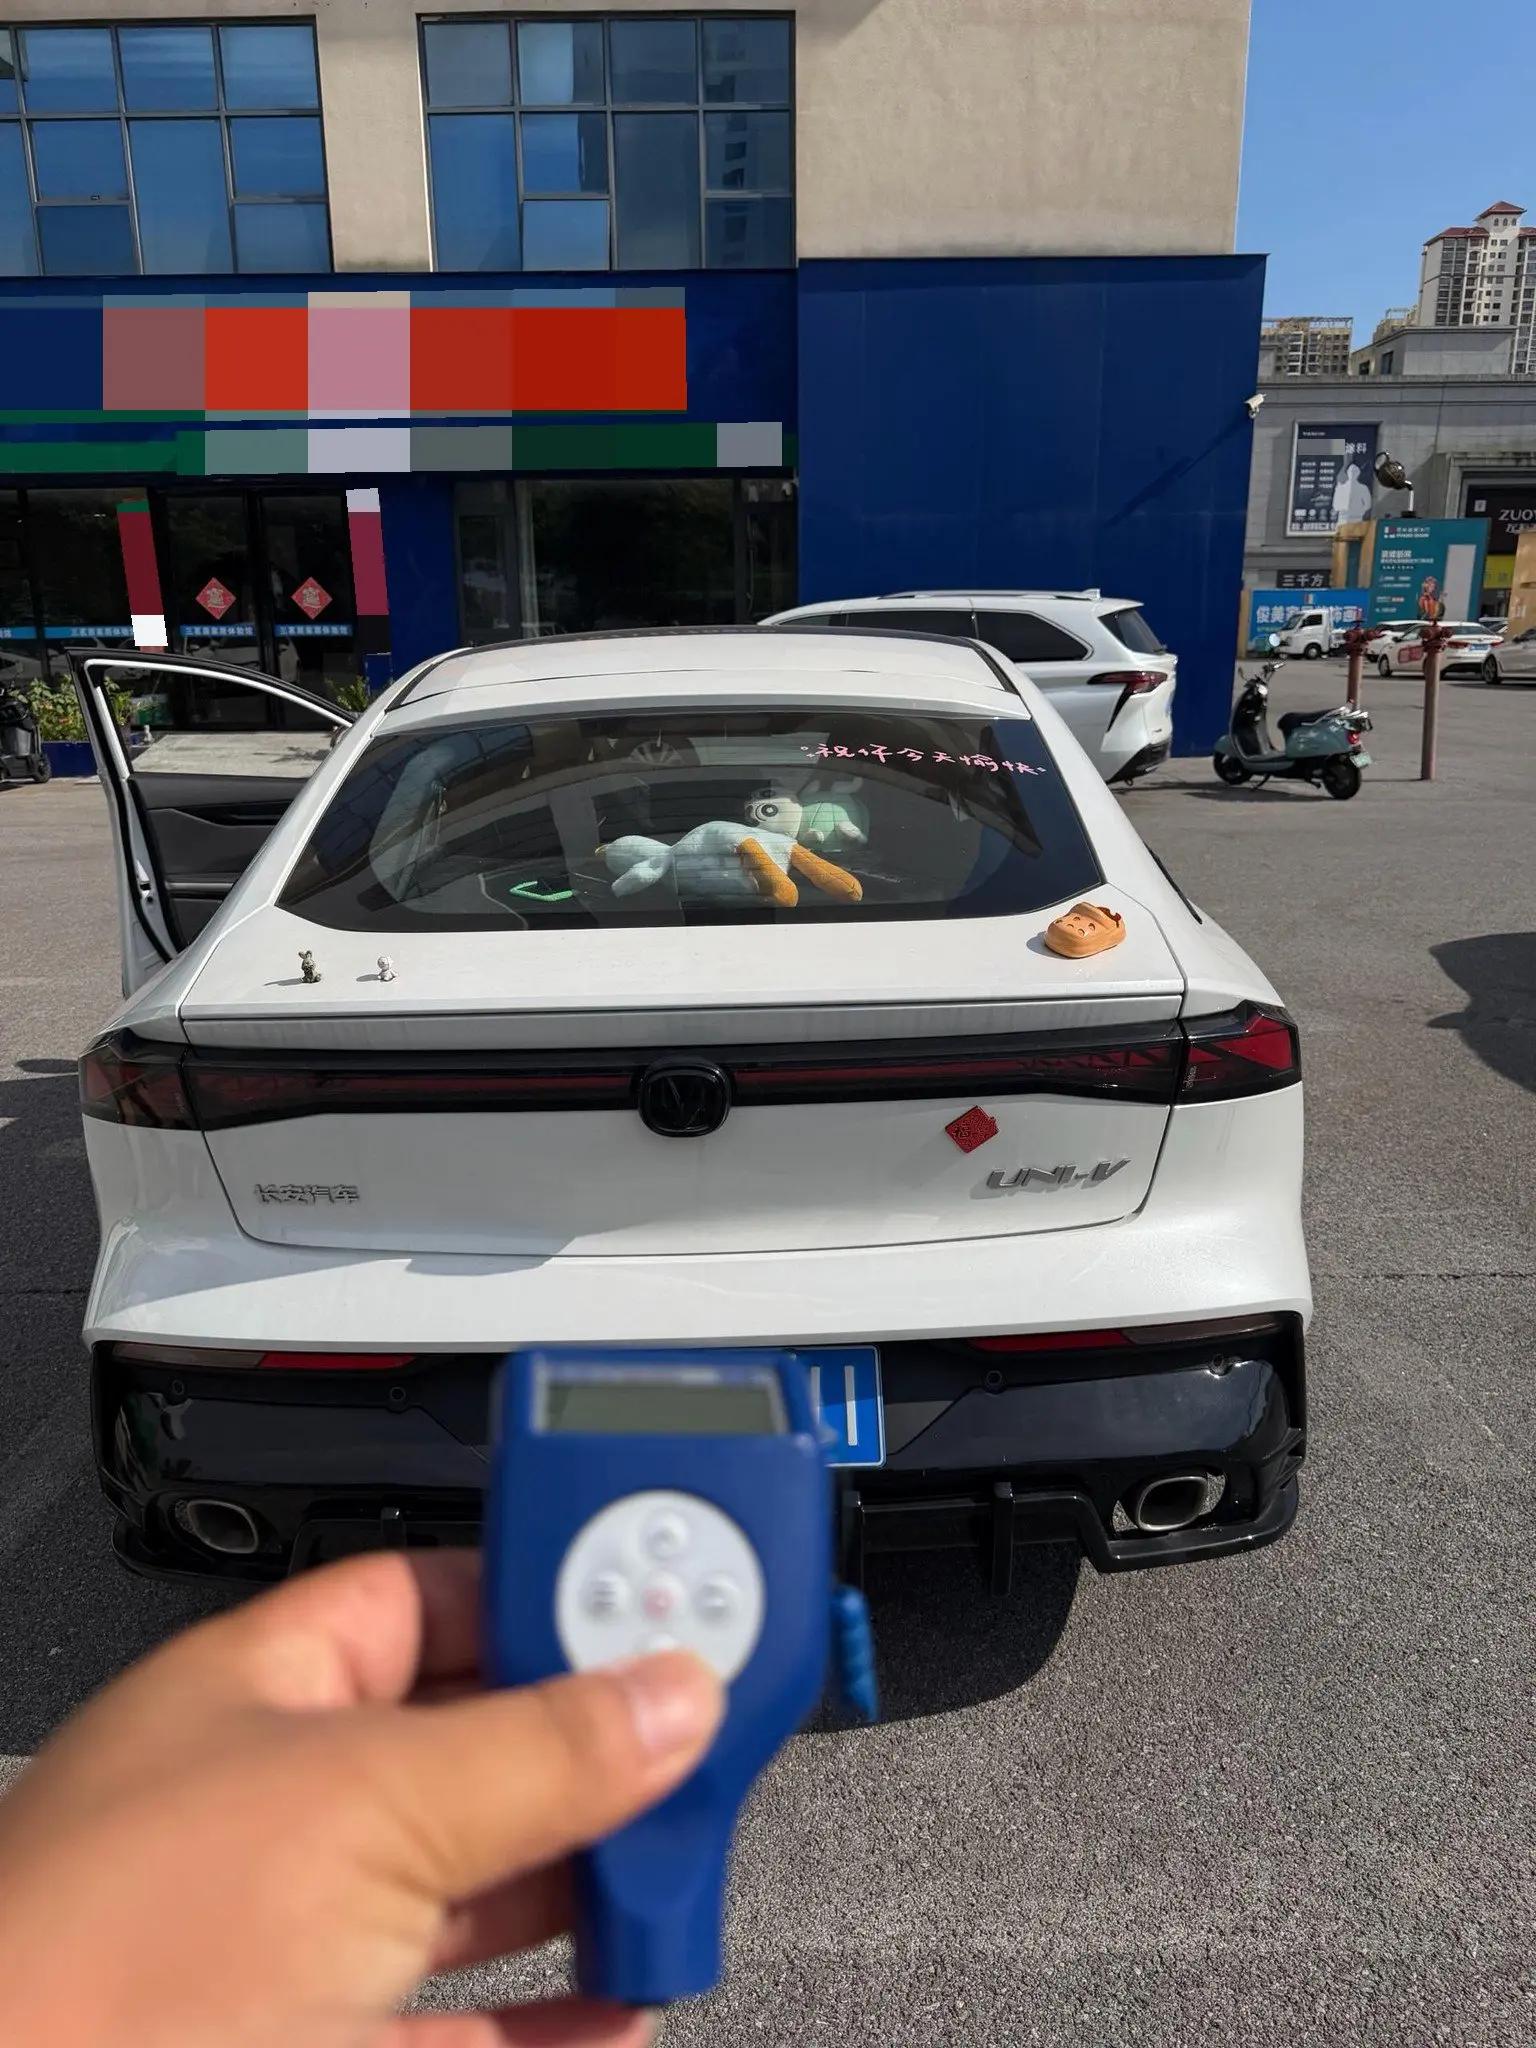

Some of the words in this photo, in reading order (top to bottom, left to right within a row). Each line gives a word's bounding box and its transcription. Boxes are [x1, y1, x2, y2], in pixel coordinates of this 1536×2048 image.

[1282, 574, 1324, 587] 三千方
[986, 1156, 1131, 1189] UNI-V
[254, 1183, 360, 1205] 长安汽车
